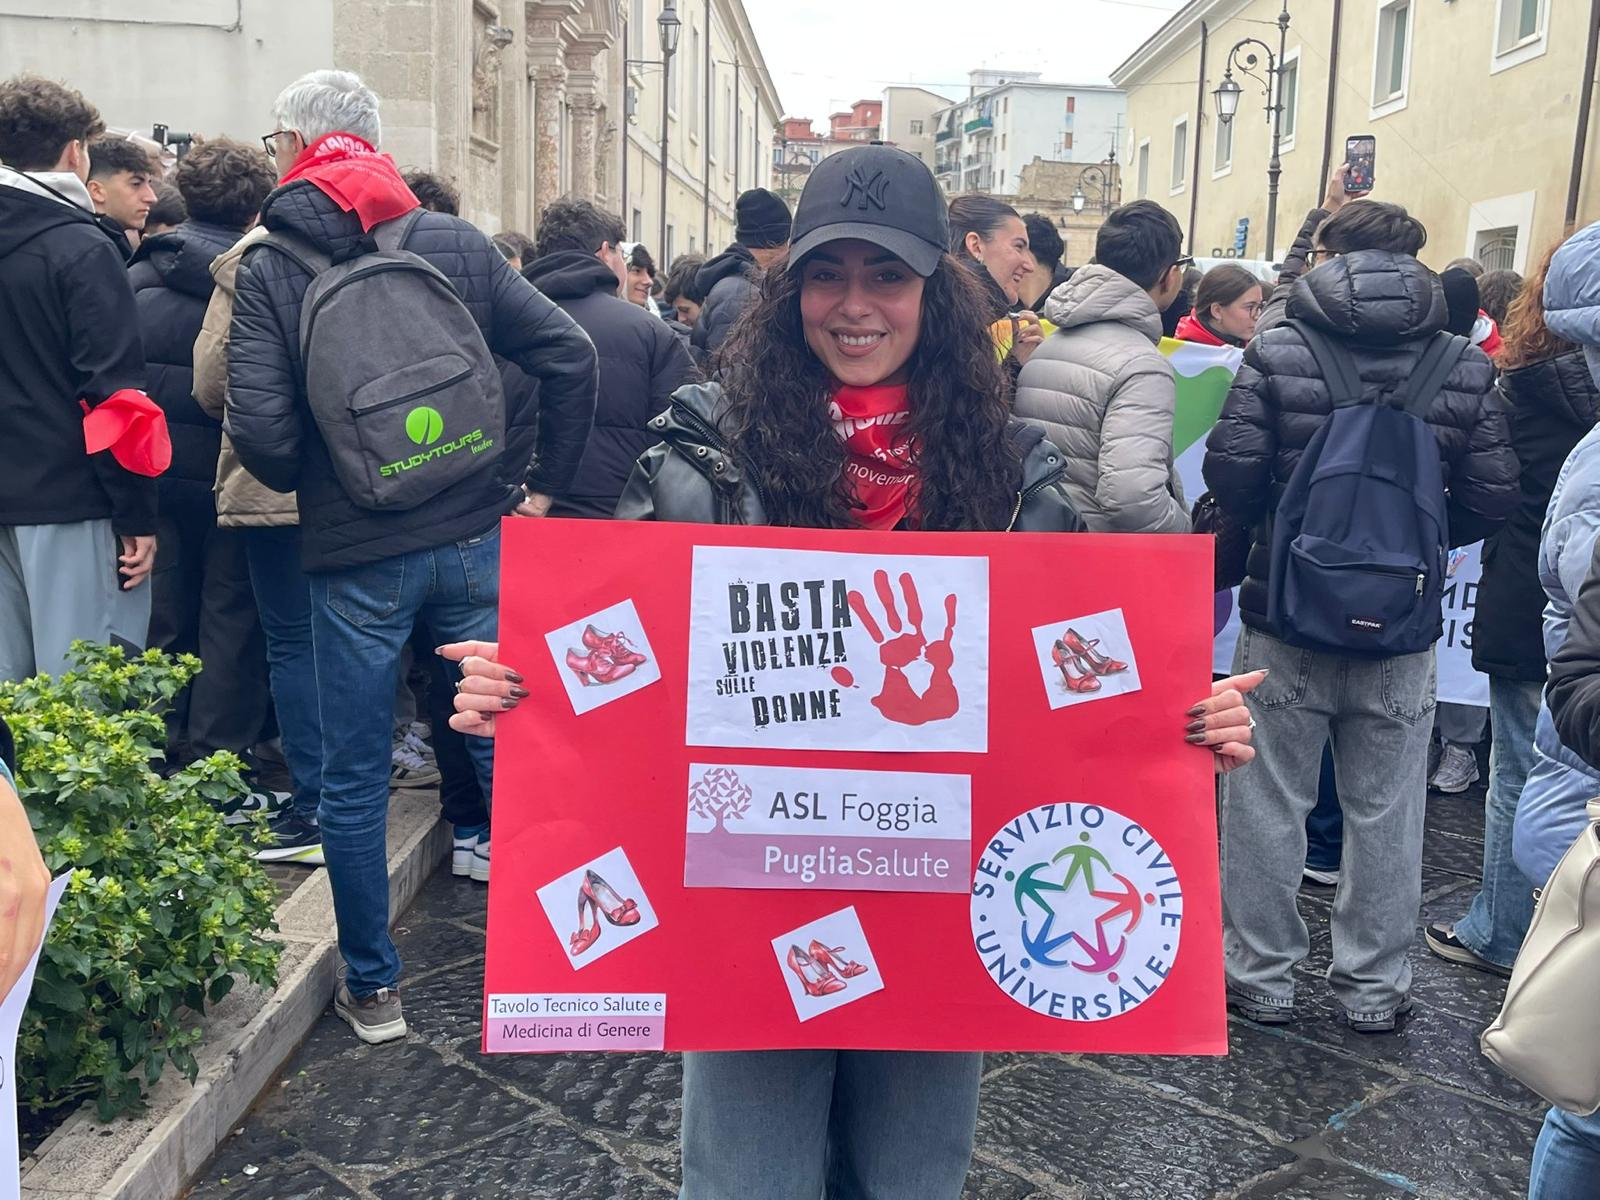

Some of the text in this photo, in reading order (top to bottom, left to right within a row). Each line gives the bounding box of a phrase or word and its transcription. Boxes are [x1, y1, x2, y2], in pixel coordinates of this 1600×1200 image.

[380, 429, 483, 477] STUDYTOURS
[728, 578, 852, 633] BASTA
[1351, 619, 1383, 629] EASTPAK
[722, 631, 847, 677] VIOLENZA
[716, 675, 756, 697] SULLE
[751, 689, 842, 731] DONNE
[769, 791, 938, 832] ASL Foggia
[764, 846, 949, 883] PugliaSalute
[972, 803, 1183, 928] SERVIZIO CIVILE
[975, 930, 1173, 1020] UNIVERSALE
[491, 996, 662, 1014] Tavolo Tecnico Salute e
[502, 1022, 651, 1039] Medicina di Genere
